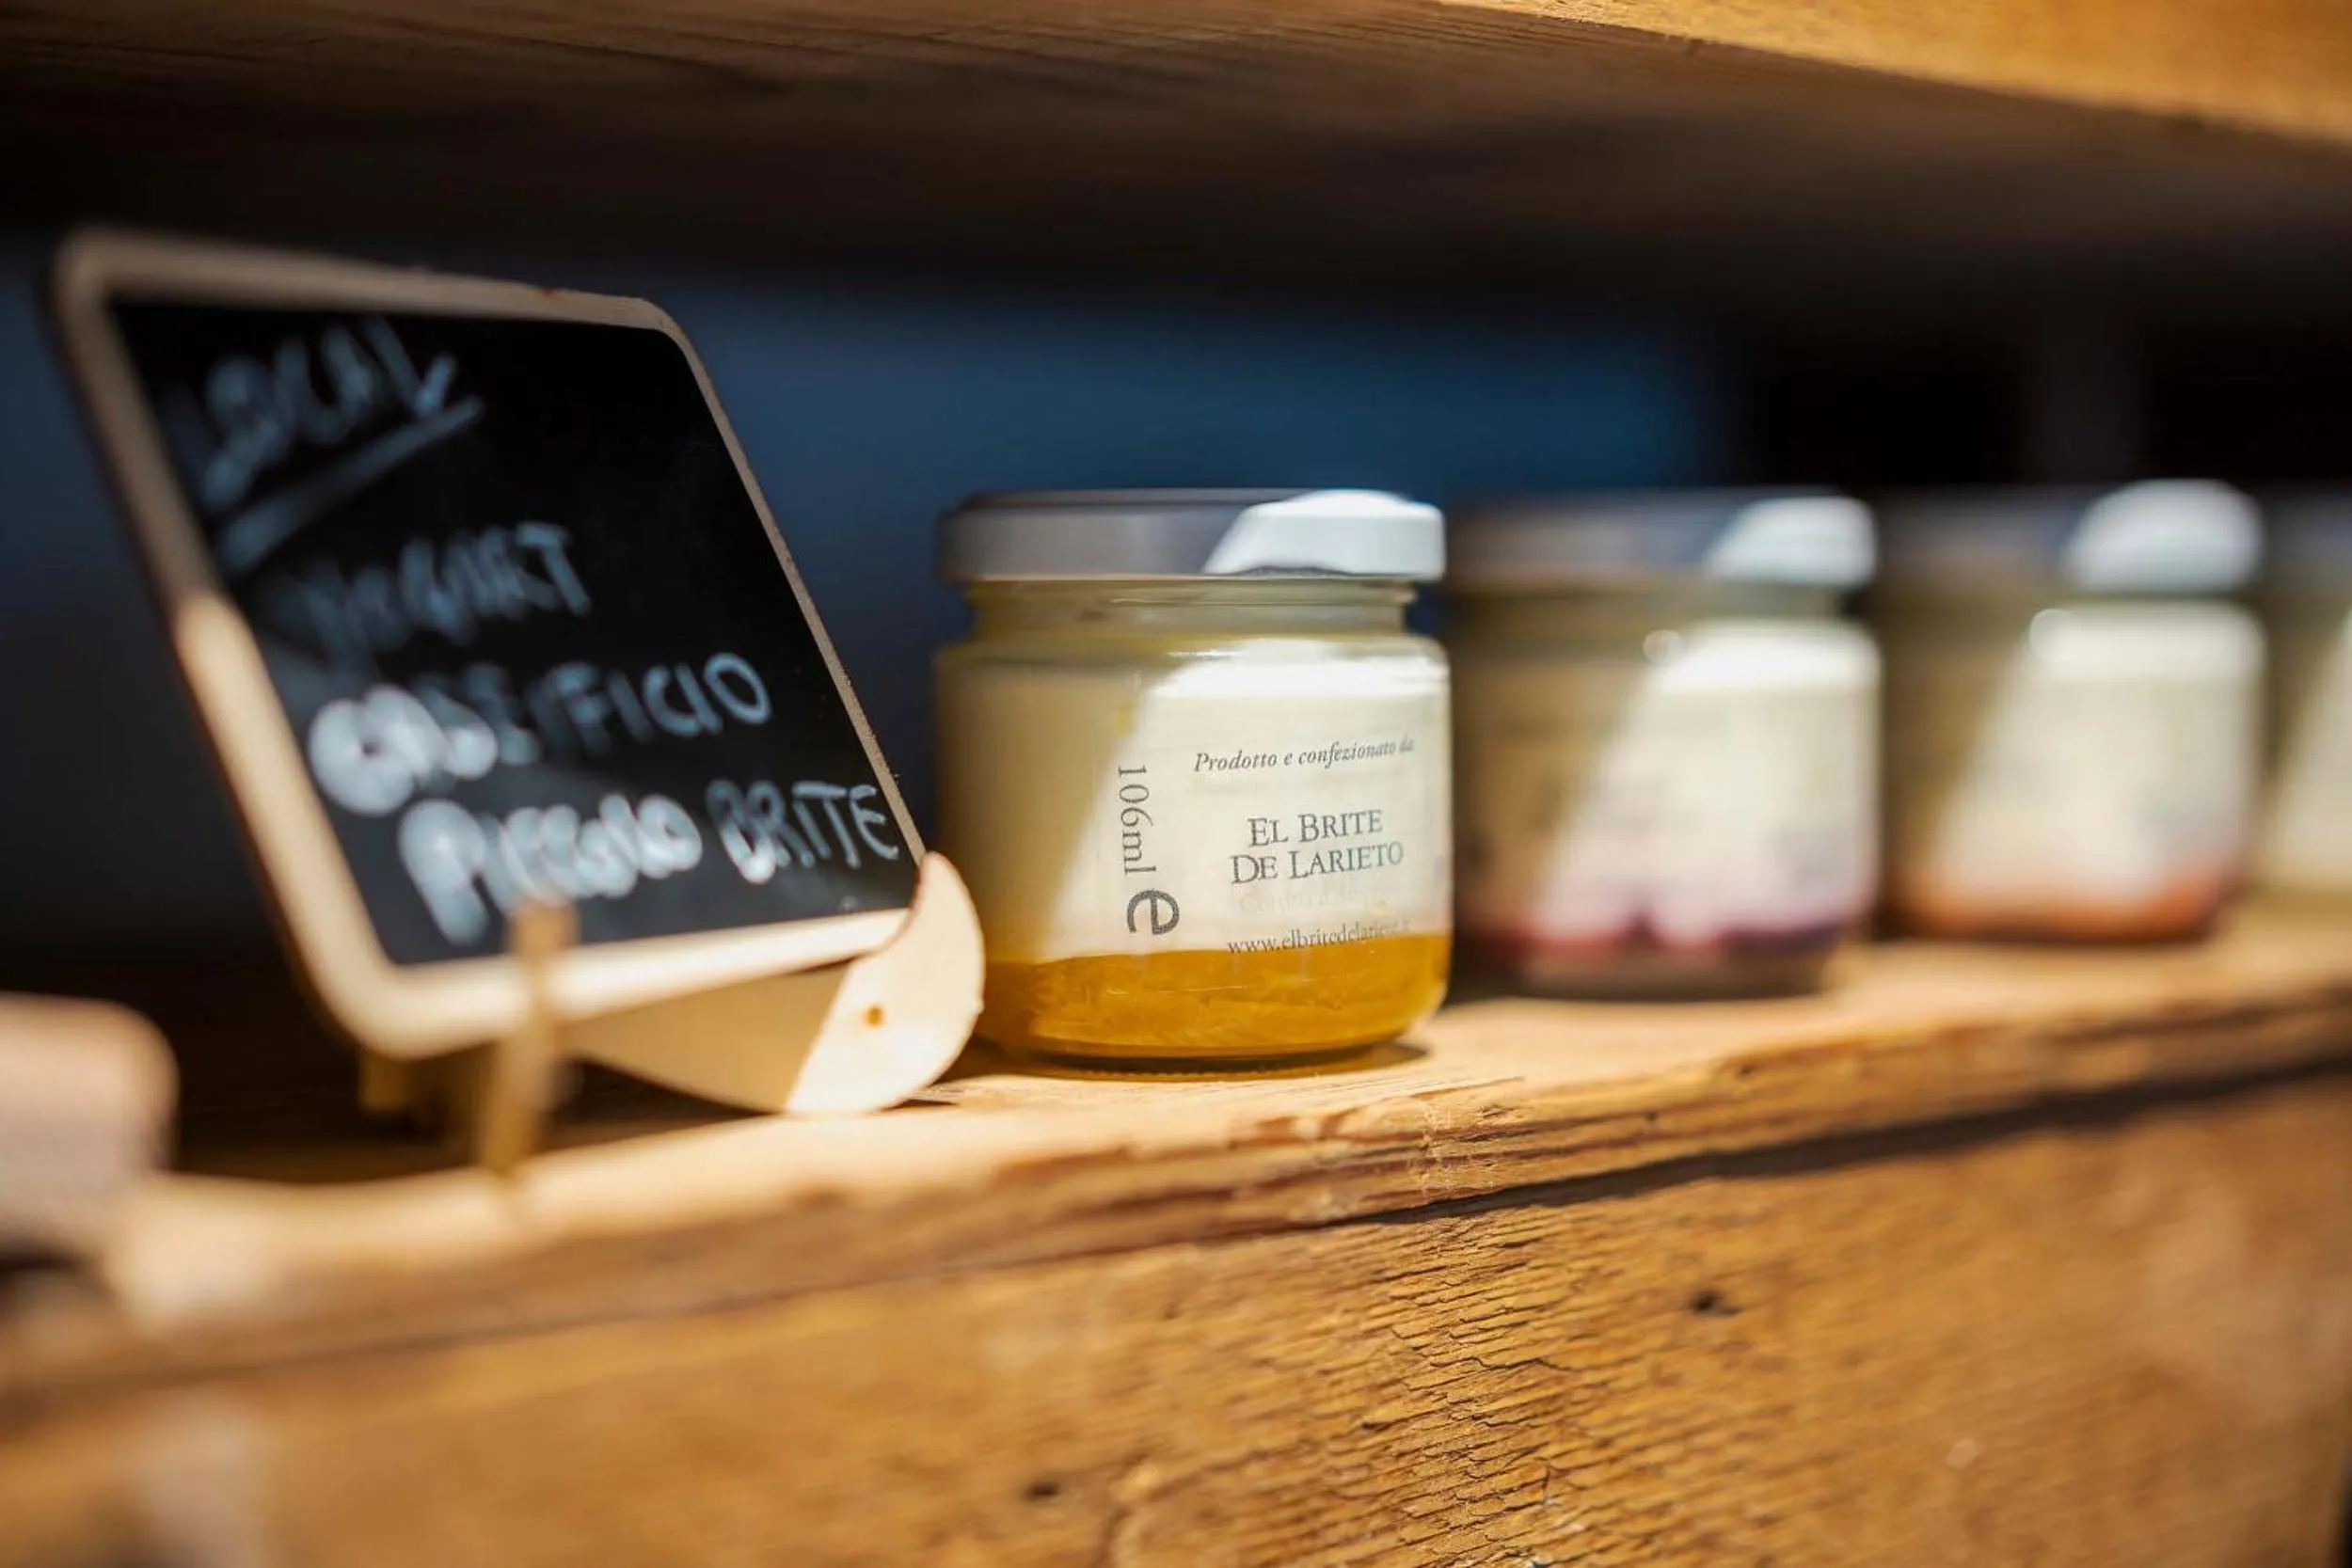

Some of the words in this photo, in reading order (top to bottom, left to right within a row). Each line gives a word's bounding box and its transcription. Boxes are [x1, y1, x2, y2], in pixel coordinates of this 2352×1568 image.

[1194, 750, 1278, 773] Prodotto
[1283, 752, 1294, 767] e
[1298, 740, 1396, 769] confezionato
[706, 780, 898, 886] BRITE
[1117, 764, 1158, 876] 106ml
